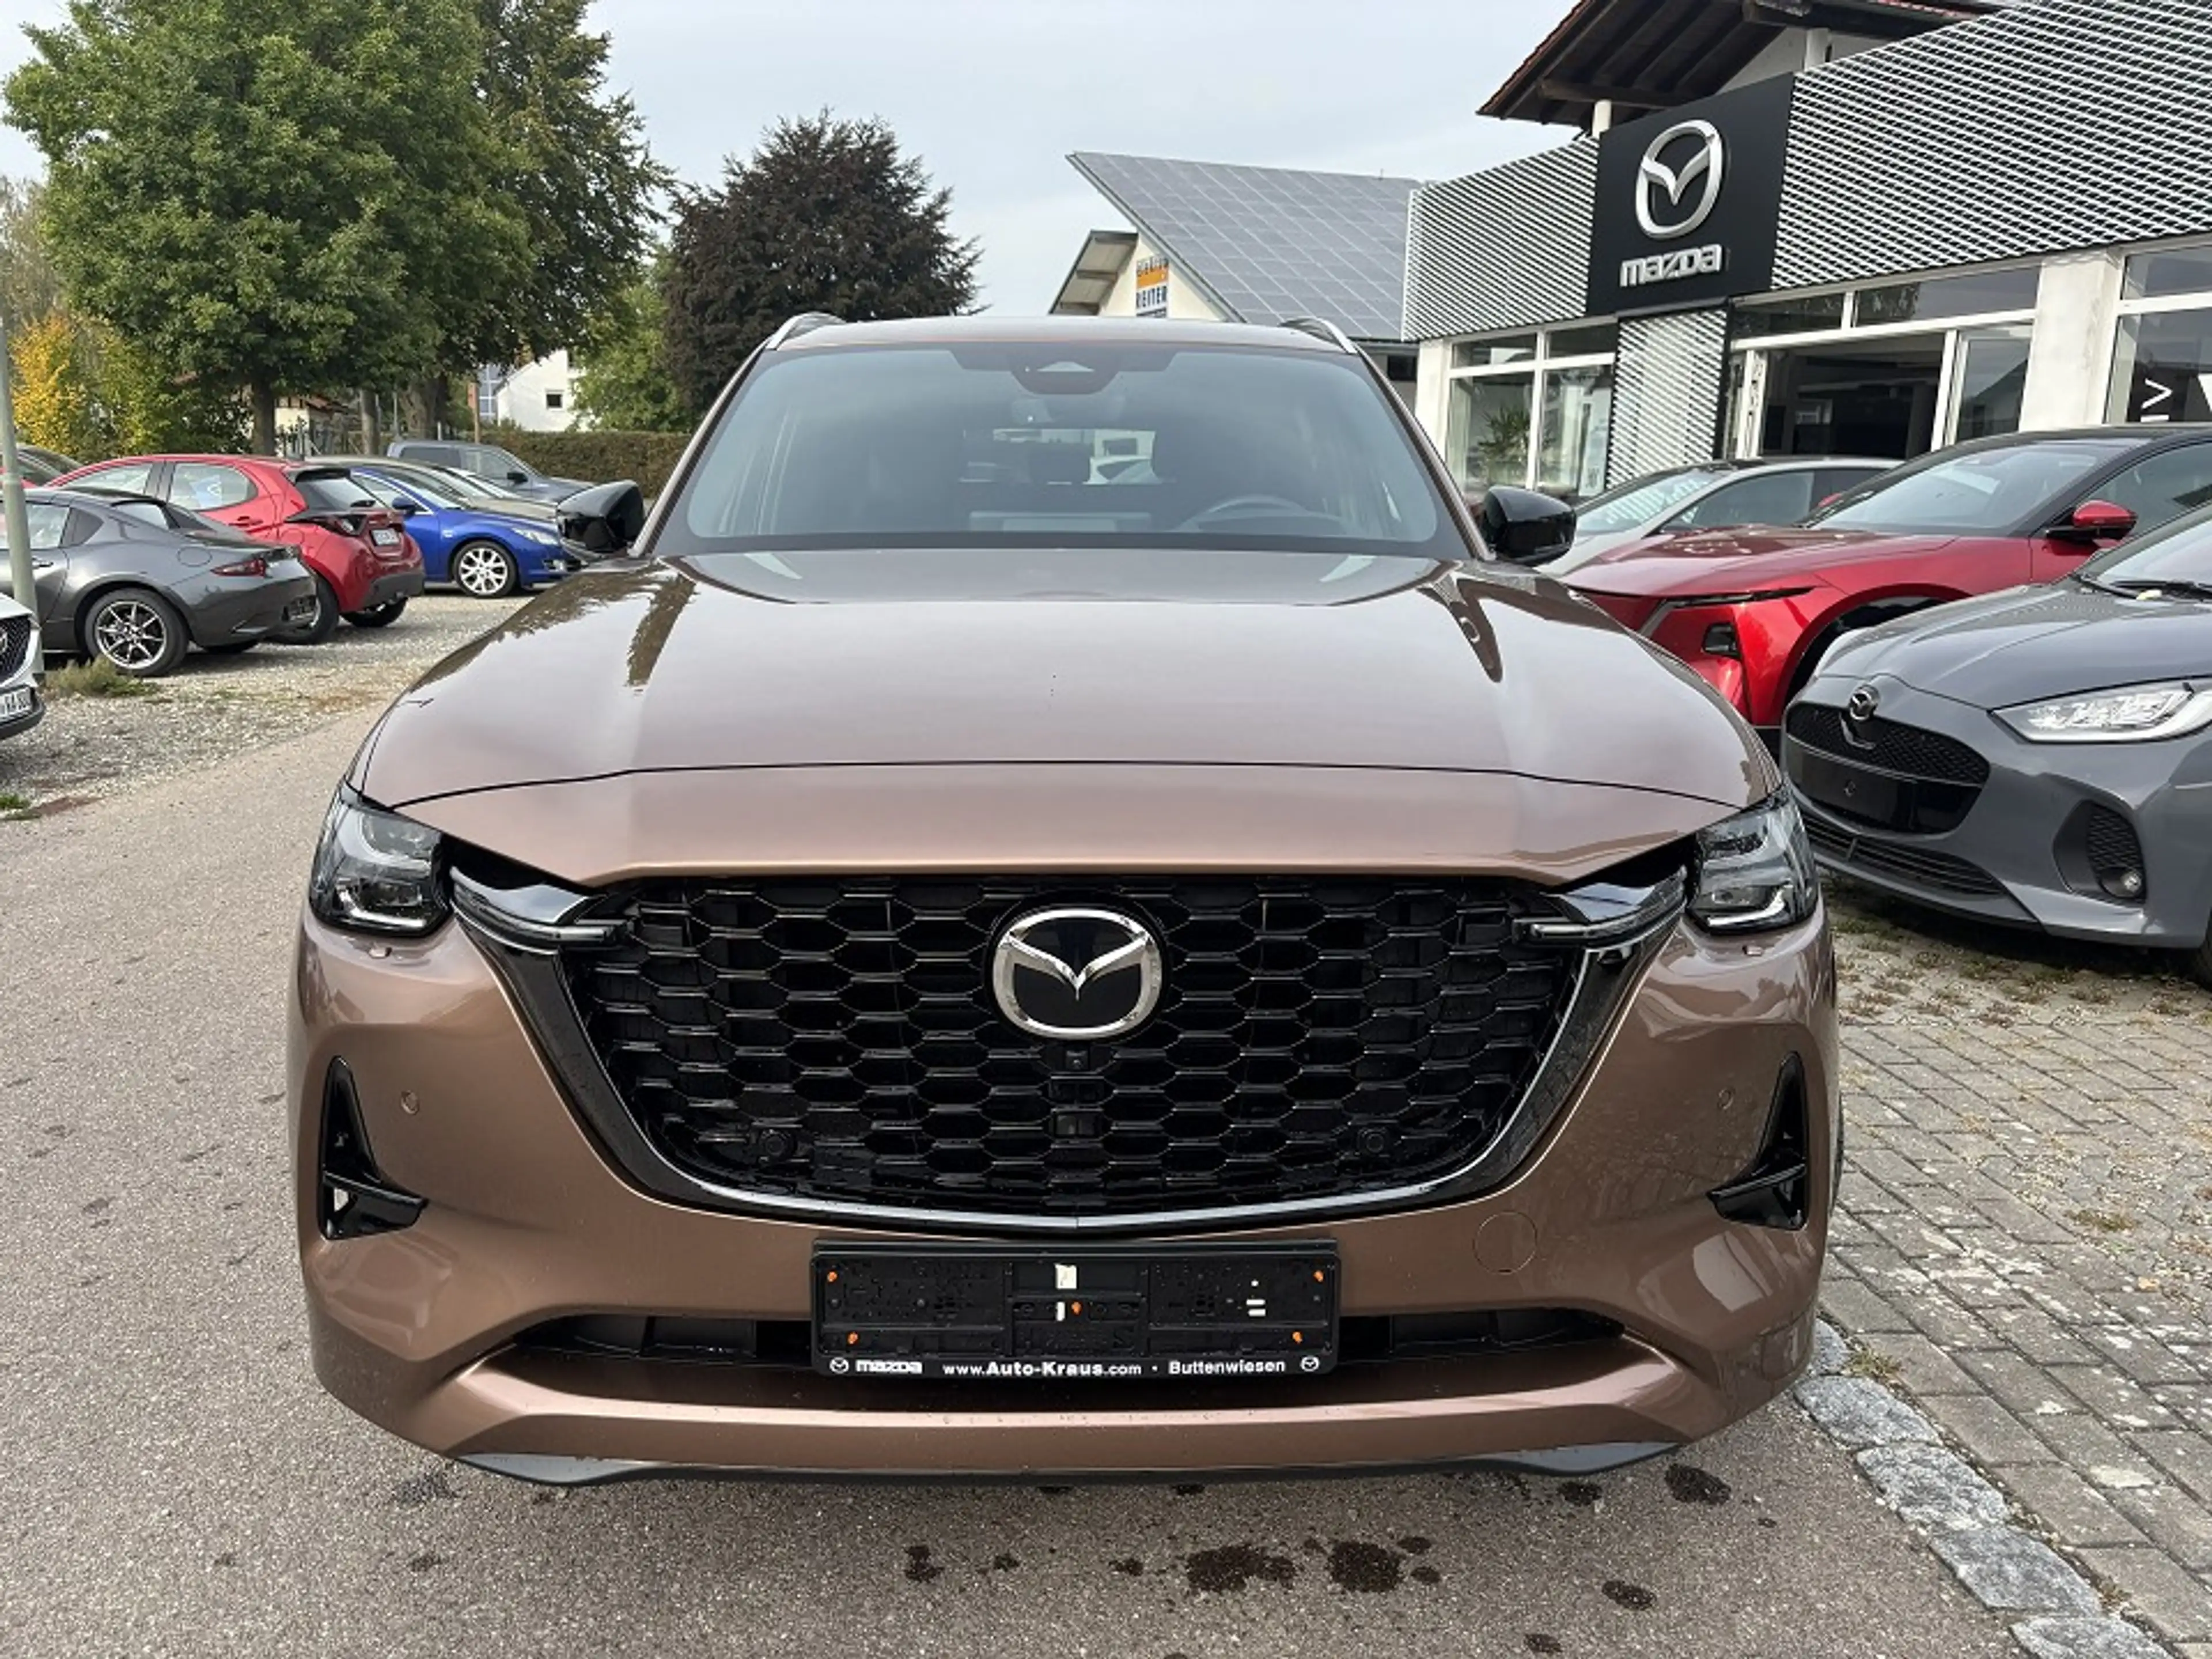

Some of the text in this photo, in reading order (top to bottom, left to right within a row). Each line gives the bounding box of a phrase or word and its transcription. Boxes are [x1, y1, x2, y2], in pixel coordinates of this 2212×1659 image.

[1619, 244, 1723, 287] mazda
[942, 1361, 1142, 1377] www.Auto-Kraus.com
[1168, 1359, 1286, 1375] Buttenwiesen
